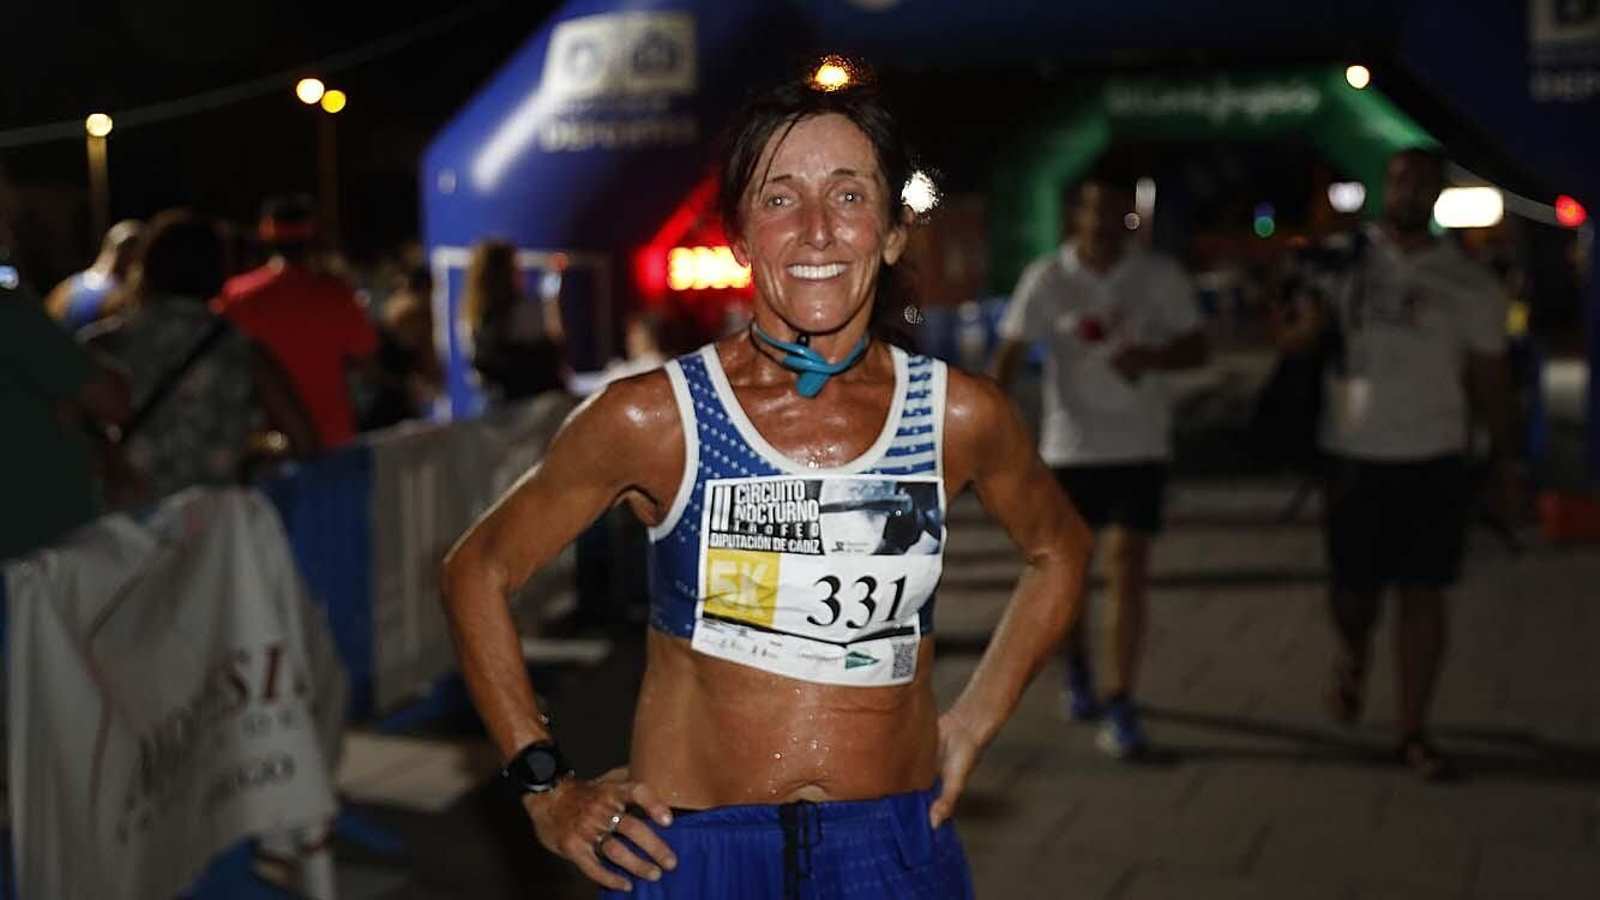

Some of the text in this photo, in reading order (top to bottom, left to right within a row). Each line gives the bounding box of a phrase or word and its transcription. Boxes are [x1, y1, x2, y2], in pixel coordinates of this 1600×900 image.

[734, 480, 805, 503] CIRCUITO
[733, 499, 820, 524] NOCTURNO
[772, 537, 787, 551] DE
[707, 558, 768, 616] 5K
[806, 574, 907, 629] 331
